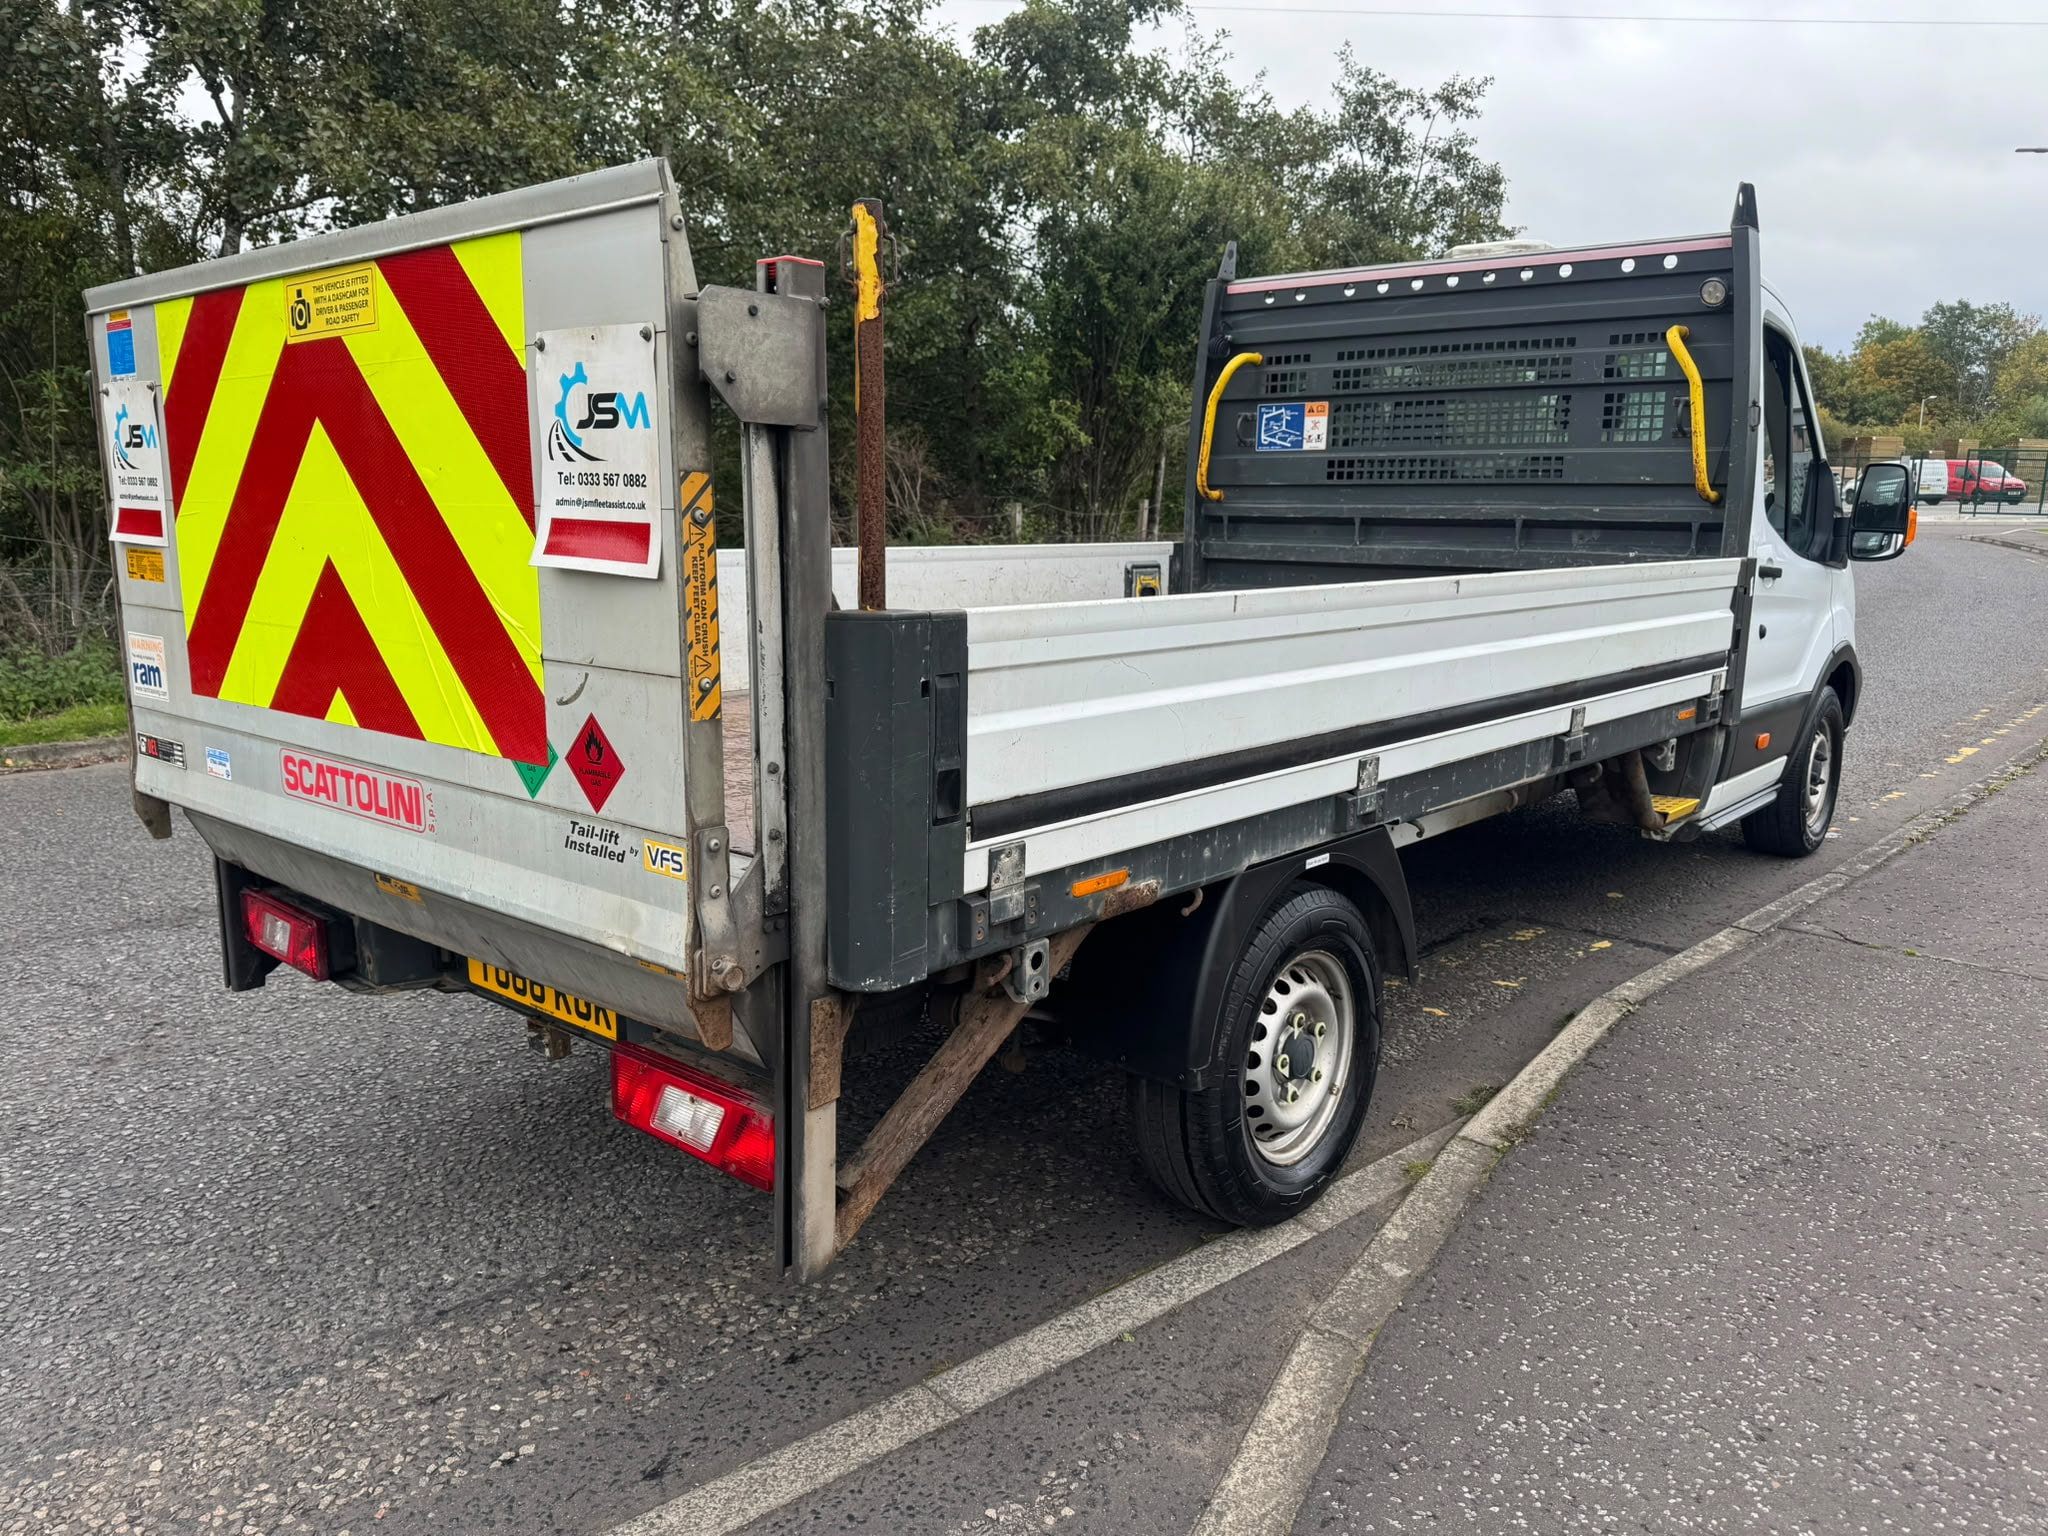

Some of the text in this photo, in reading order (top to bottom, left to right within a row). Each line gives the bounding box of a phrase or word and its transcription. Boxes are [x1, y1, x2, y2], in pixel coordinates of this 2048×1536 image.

[312, 275, 369, 293] THIS VEHICLE IS FITTED
[314, 295, 328, 305] WITH
[332, 290, 358, 302] DASHCAM
[358, 287, 369, 297] FOR
[316, 306, 334, 316] DRIVER
[339, 299, 369, 312] PASSENGER
[325, 313, 360, 326] ROAD SAFETY
[576, 391, 651, 430] JSM
[125, 424, 157, 449] JSM
[557, 472, 647, 488] Tel: 0333 567 0882
[555, 497, 646, 510] admin@jsmfleetassist.co.uk
[698, 543, 709, 657] PLATFORM CAN CRUSH
[694, 612, 702, 645] CLEAR
[132, 662, 163, 688] ram
[526, 764, 537, 773] GAS
[578, 767, 612, 780] FLAMMABLE
[283, 754, 423, 827] SCATTOLINI
[570, 820, 620, 846] Tail-lift
[564, 835, 683, 873] Installed by VFS
